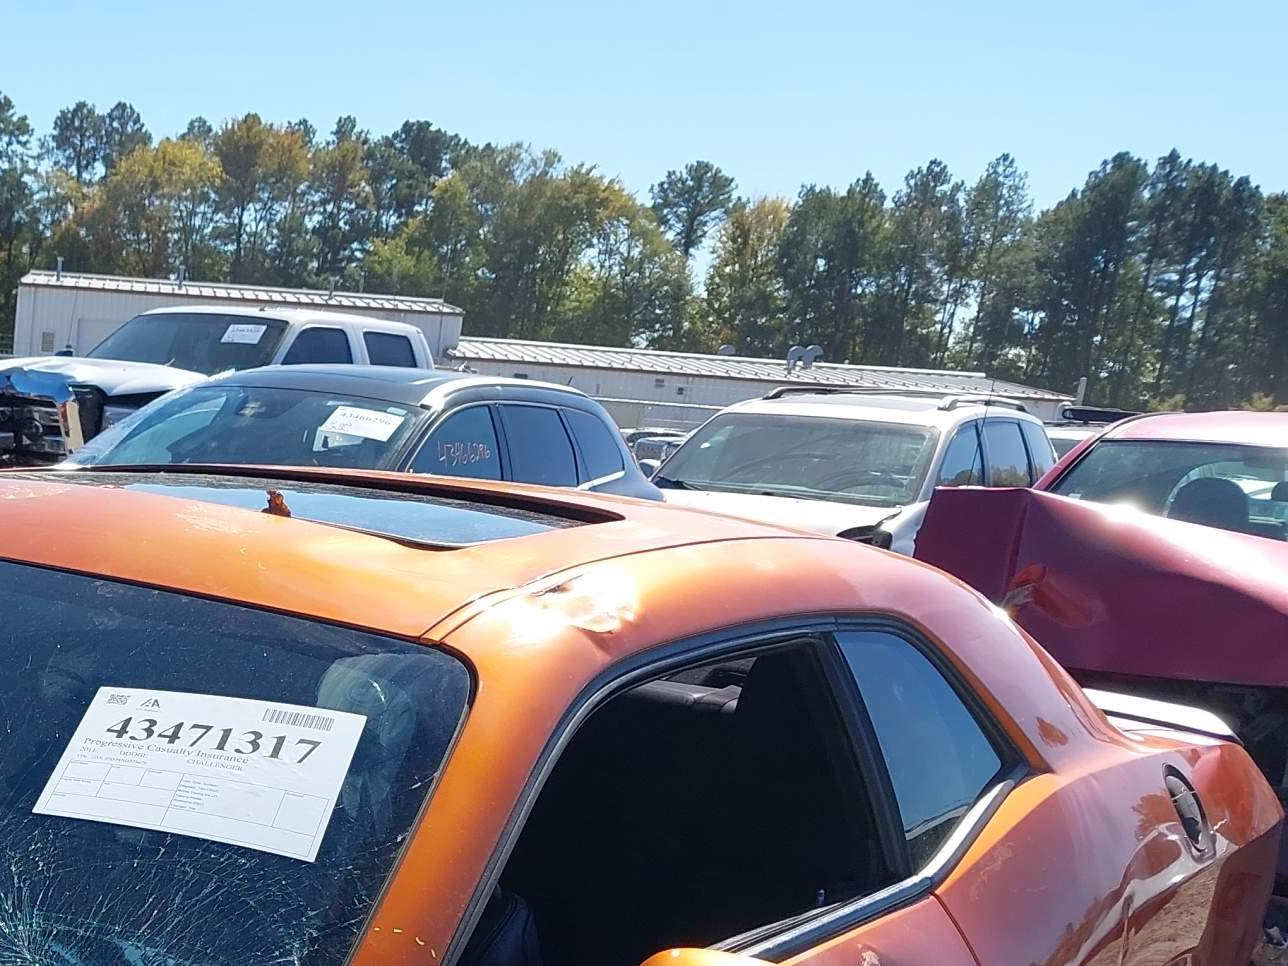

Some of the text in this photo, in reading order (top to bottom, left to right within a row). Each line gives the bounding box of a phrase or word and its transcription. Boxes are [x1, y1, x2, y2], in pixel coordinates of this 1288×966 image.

[83, 737, 249, 764] Progressive Casualty Insurance
[105, 716, 322, 764] 43471317
[186, 758, 244, 772] CHALLENGER
